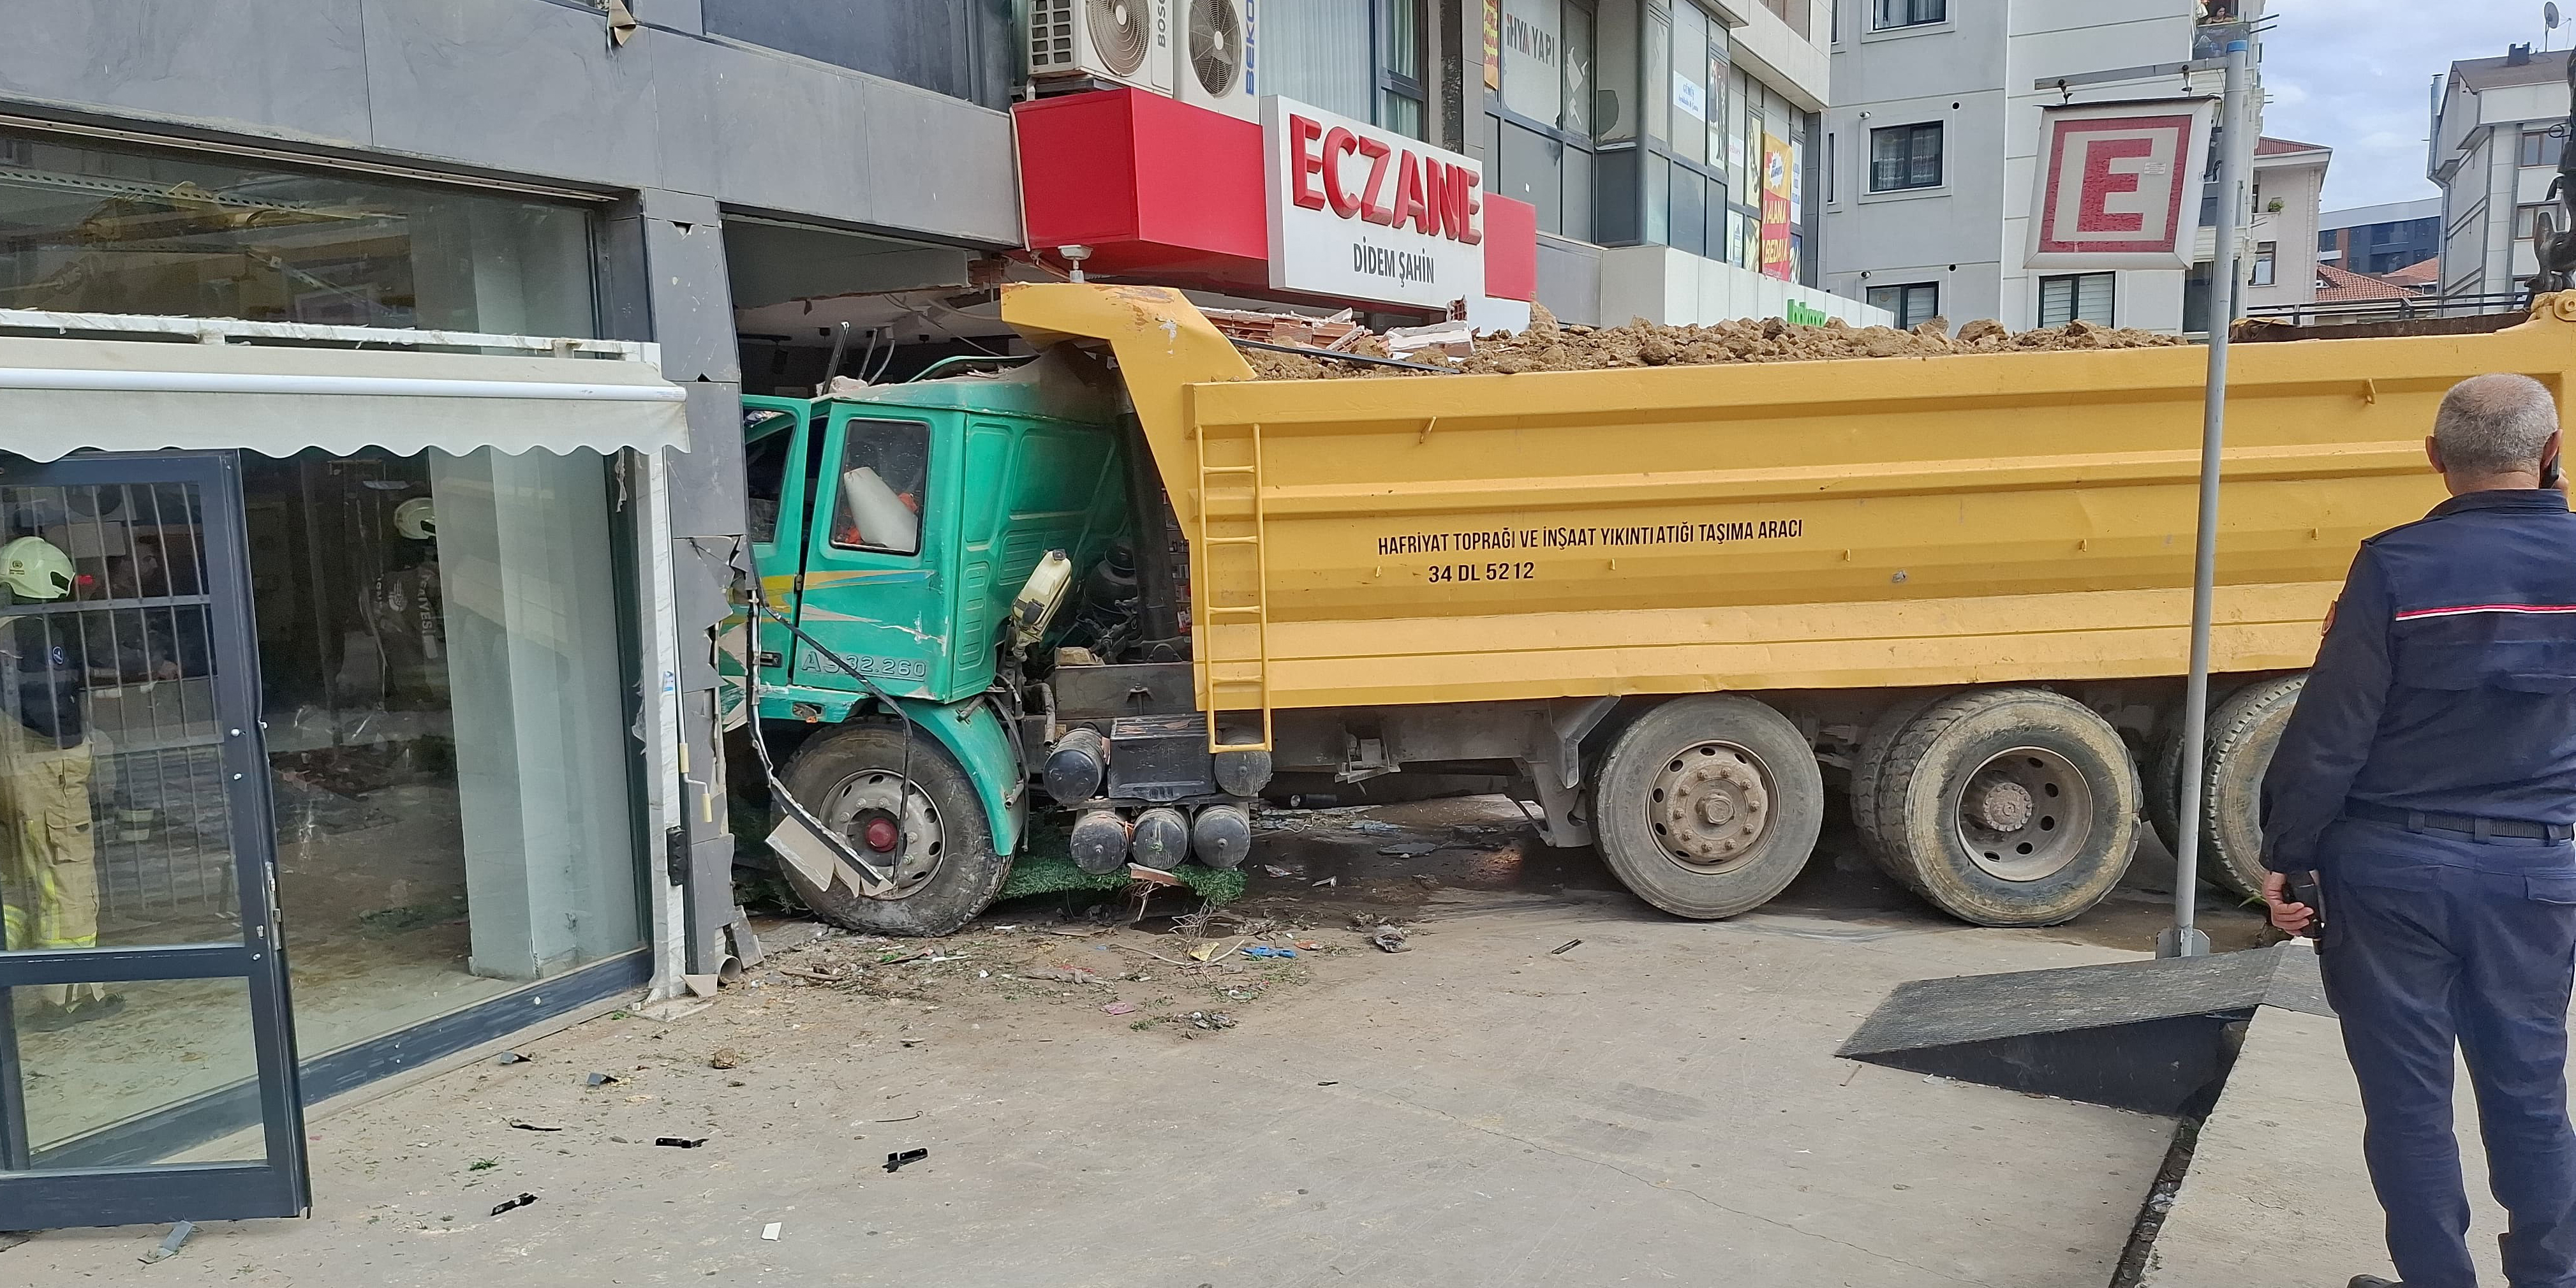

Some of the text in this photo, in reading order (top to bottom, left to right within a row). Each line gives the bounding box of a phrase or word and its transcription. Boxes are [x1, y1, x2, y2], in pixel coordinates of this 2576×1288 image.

[1246, 0, 1255, 95] BEKO
[1532, 26, 1555, 68] YAPI
[1290, 113, 1482, 246] ECZANE
[2076, 138, 2153, 232] E
[1766, 200, 1787, 224] ALANA
[1353, 235, 1434, 288] DİDEM ŞAHİN
[1378, 519, 1803, 556] HAFRİYAT TOPRAĞI VE İNŞAAT YIKINTI ATIĞI TAŞIMA ARACI
[1428, 561, 1535, 583] 34 DL 5212
[845, 655, 926, 677] 32.260
